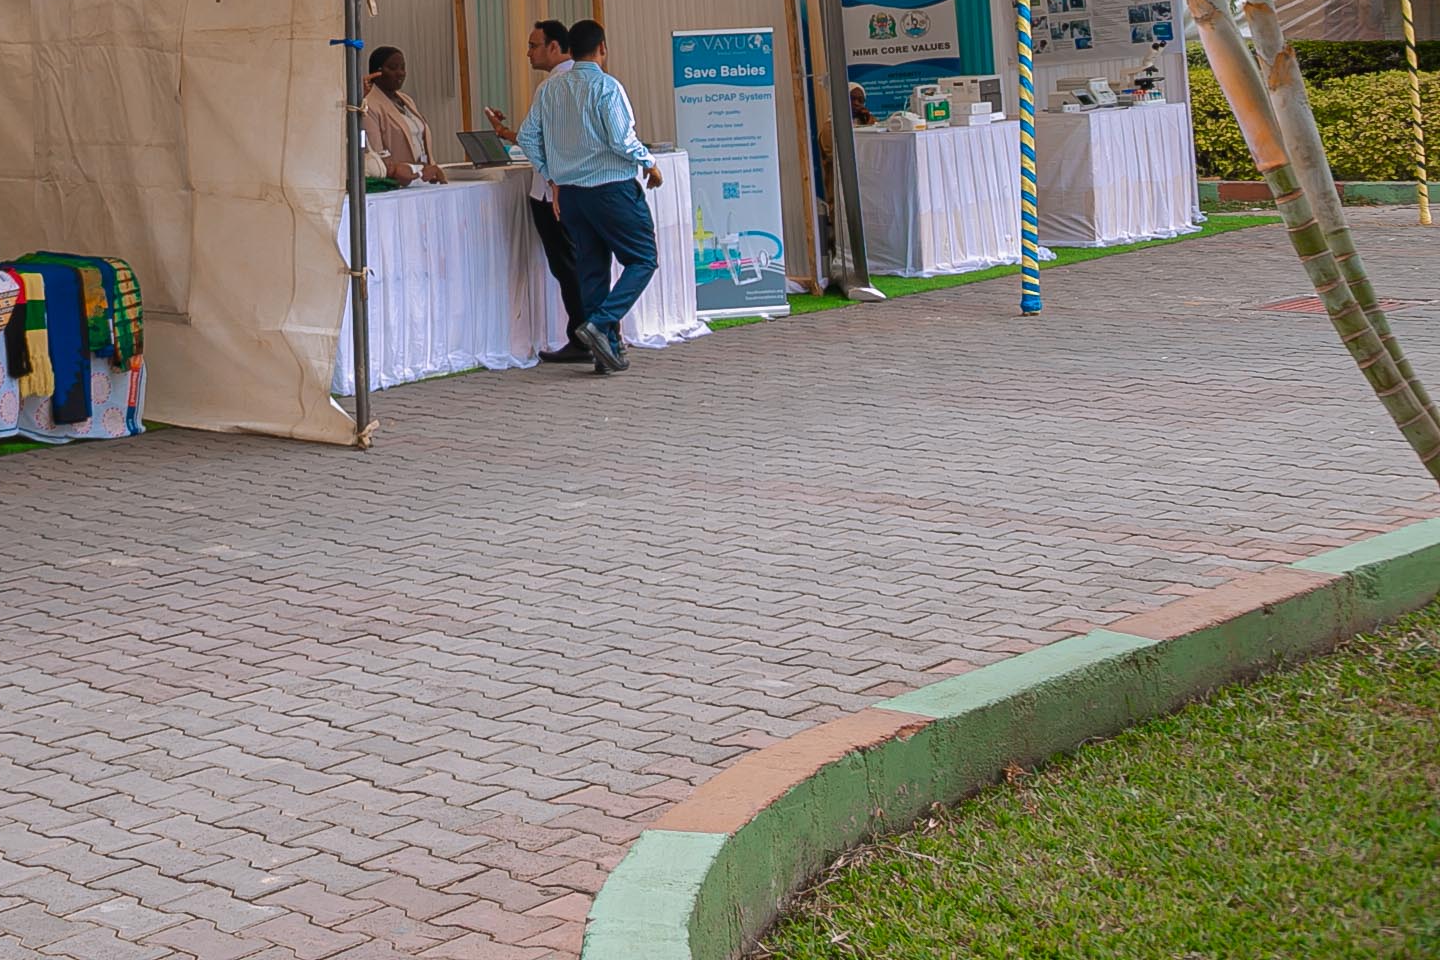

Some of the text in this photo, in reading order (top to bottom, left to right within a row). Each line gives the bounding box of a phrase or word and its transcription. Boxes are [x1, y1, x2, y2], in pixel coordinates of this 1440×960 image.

[702, 35, 746, 50] VAYU
[852, 42, 951, 57] NIMR CORE VALUES
[683, 63, 766, 79] Save Babies
[680, 92, 772, 104] Vayu bCPAP System
